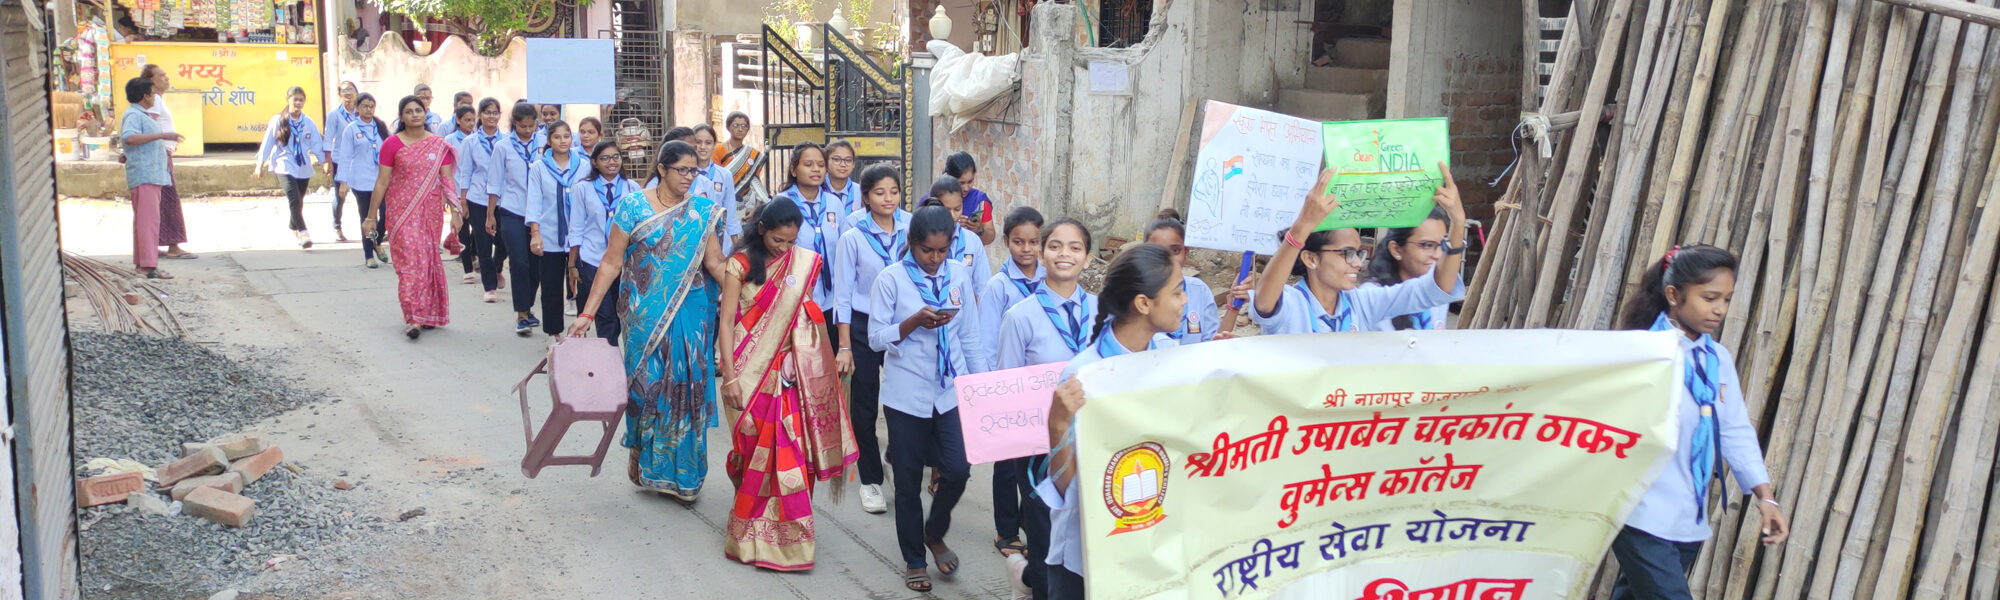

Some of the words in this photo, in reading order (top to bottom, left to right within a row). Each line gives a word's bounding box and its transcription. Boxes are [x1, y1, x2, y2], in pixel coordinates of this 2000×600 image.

[113, 57, 135, 70] शुभ
[290, 56, 314, 67] लाभ
[229, 86, 256, 106] शॉप
[1380, 142, 1404, 152] Green
[1323, 388, 1347, 409] श्री
[1184, 415, 1289, 479] श्रीमती
[1292, 412, 1410, 455] उषाबेन
[1414, 402, 1534, 445] चंद्रकांत
[1536, 414, 1643, 459] ठाकर
[1277, 464, 1376, 528] वुमेन्स
[1379, 453, 1484, 496] कॉलेज
[1213, 538, 1305, 598] राष्ट्रीय
[1319, 522, 1391, 560] सेवा
[1405, 510, 1536, 543] योजना
